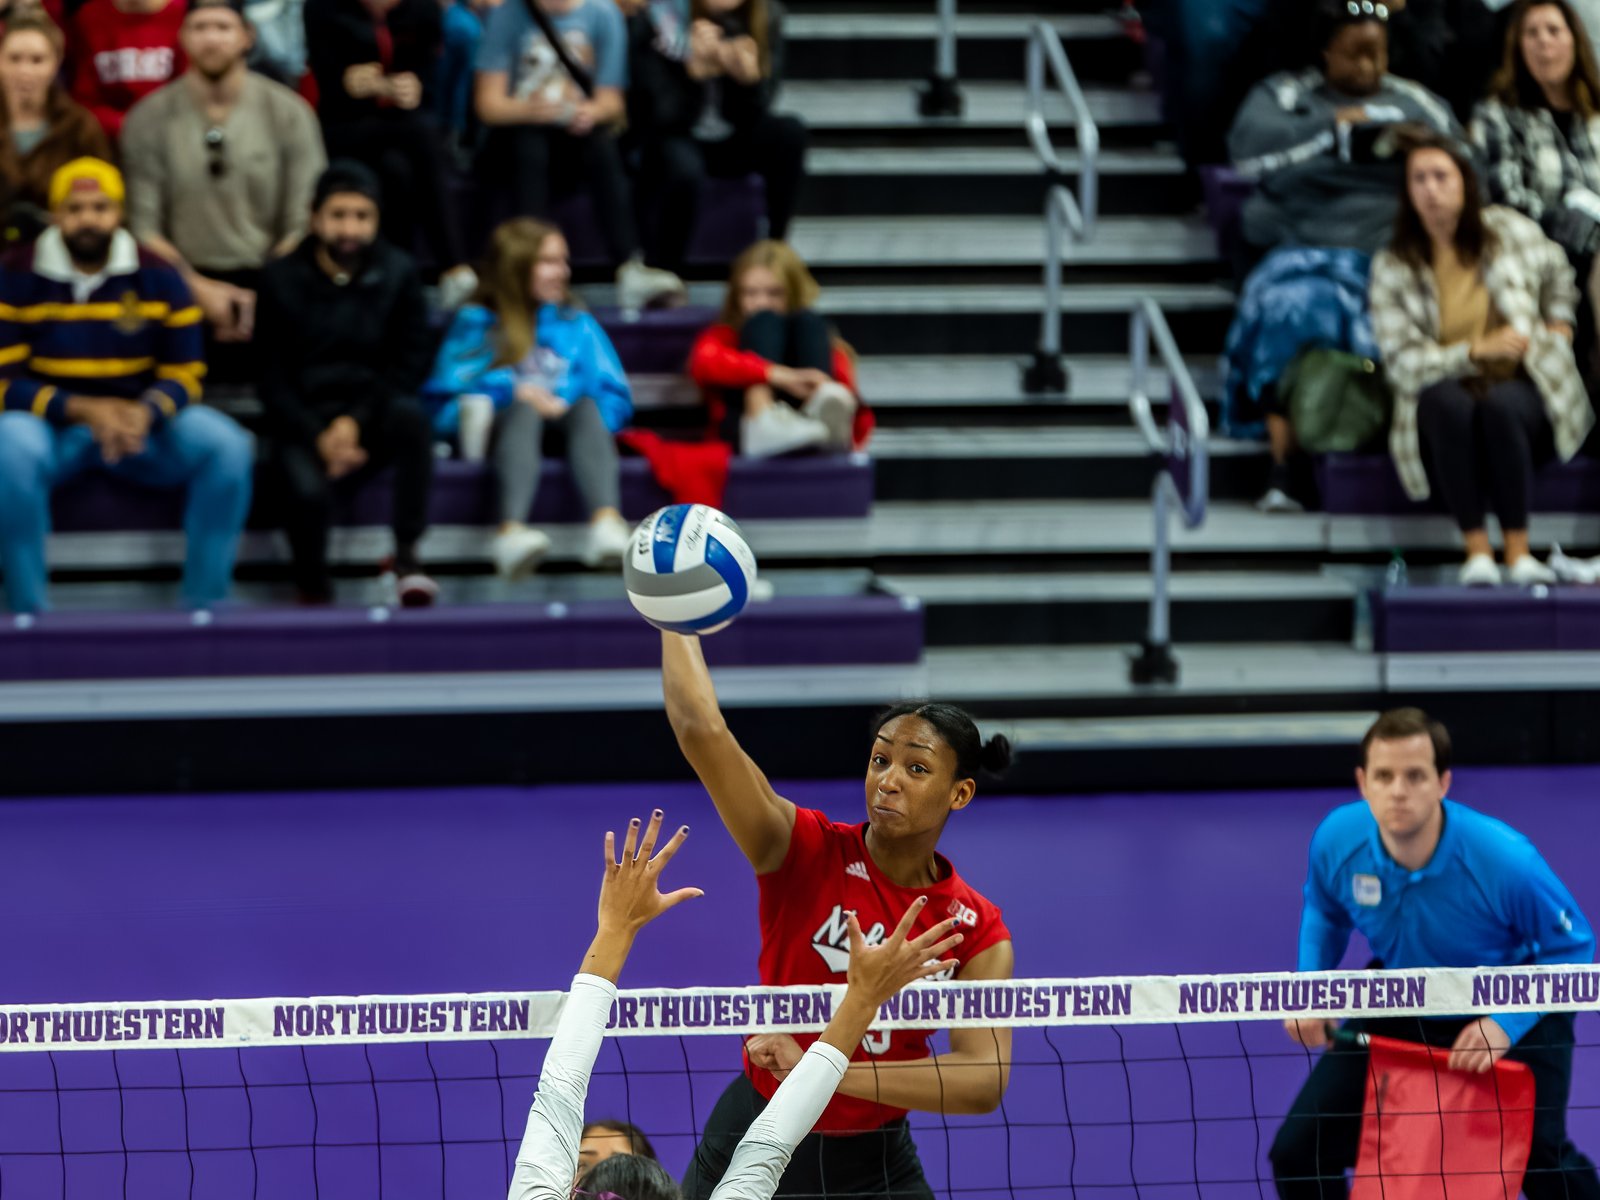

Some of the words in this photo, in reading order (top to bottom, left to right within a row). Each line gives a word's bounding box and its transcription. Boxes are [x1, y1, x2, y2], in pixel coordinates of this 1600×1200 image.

[273, 999, 530, 1038] NORTHWESTERN
[604, 991, 832, 1029] RTHWESTERN
[880, 983, 1132, 1021] NORTHWESTERN
[1178, 976, 1426, 1014] NORTHWESTERN
[1472, 972, 1600, 1005] NORTHW
